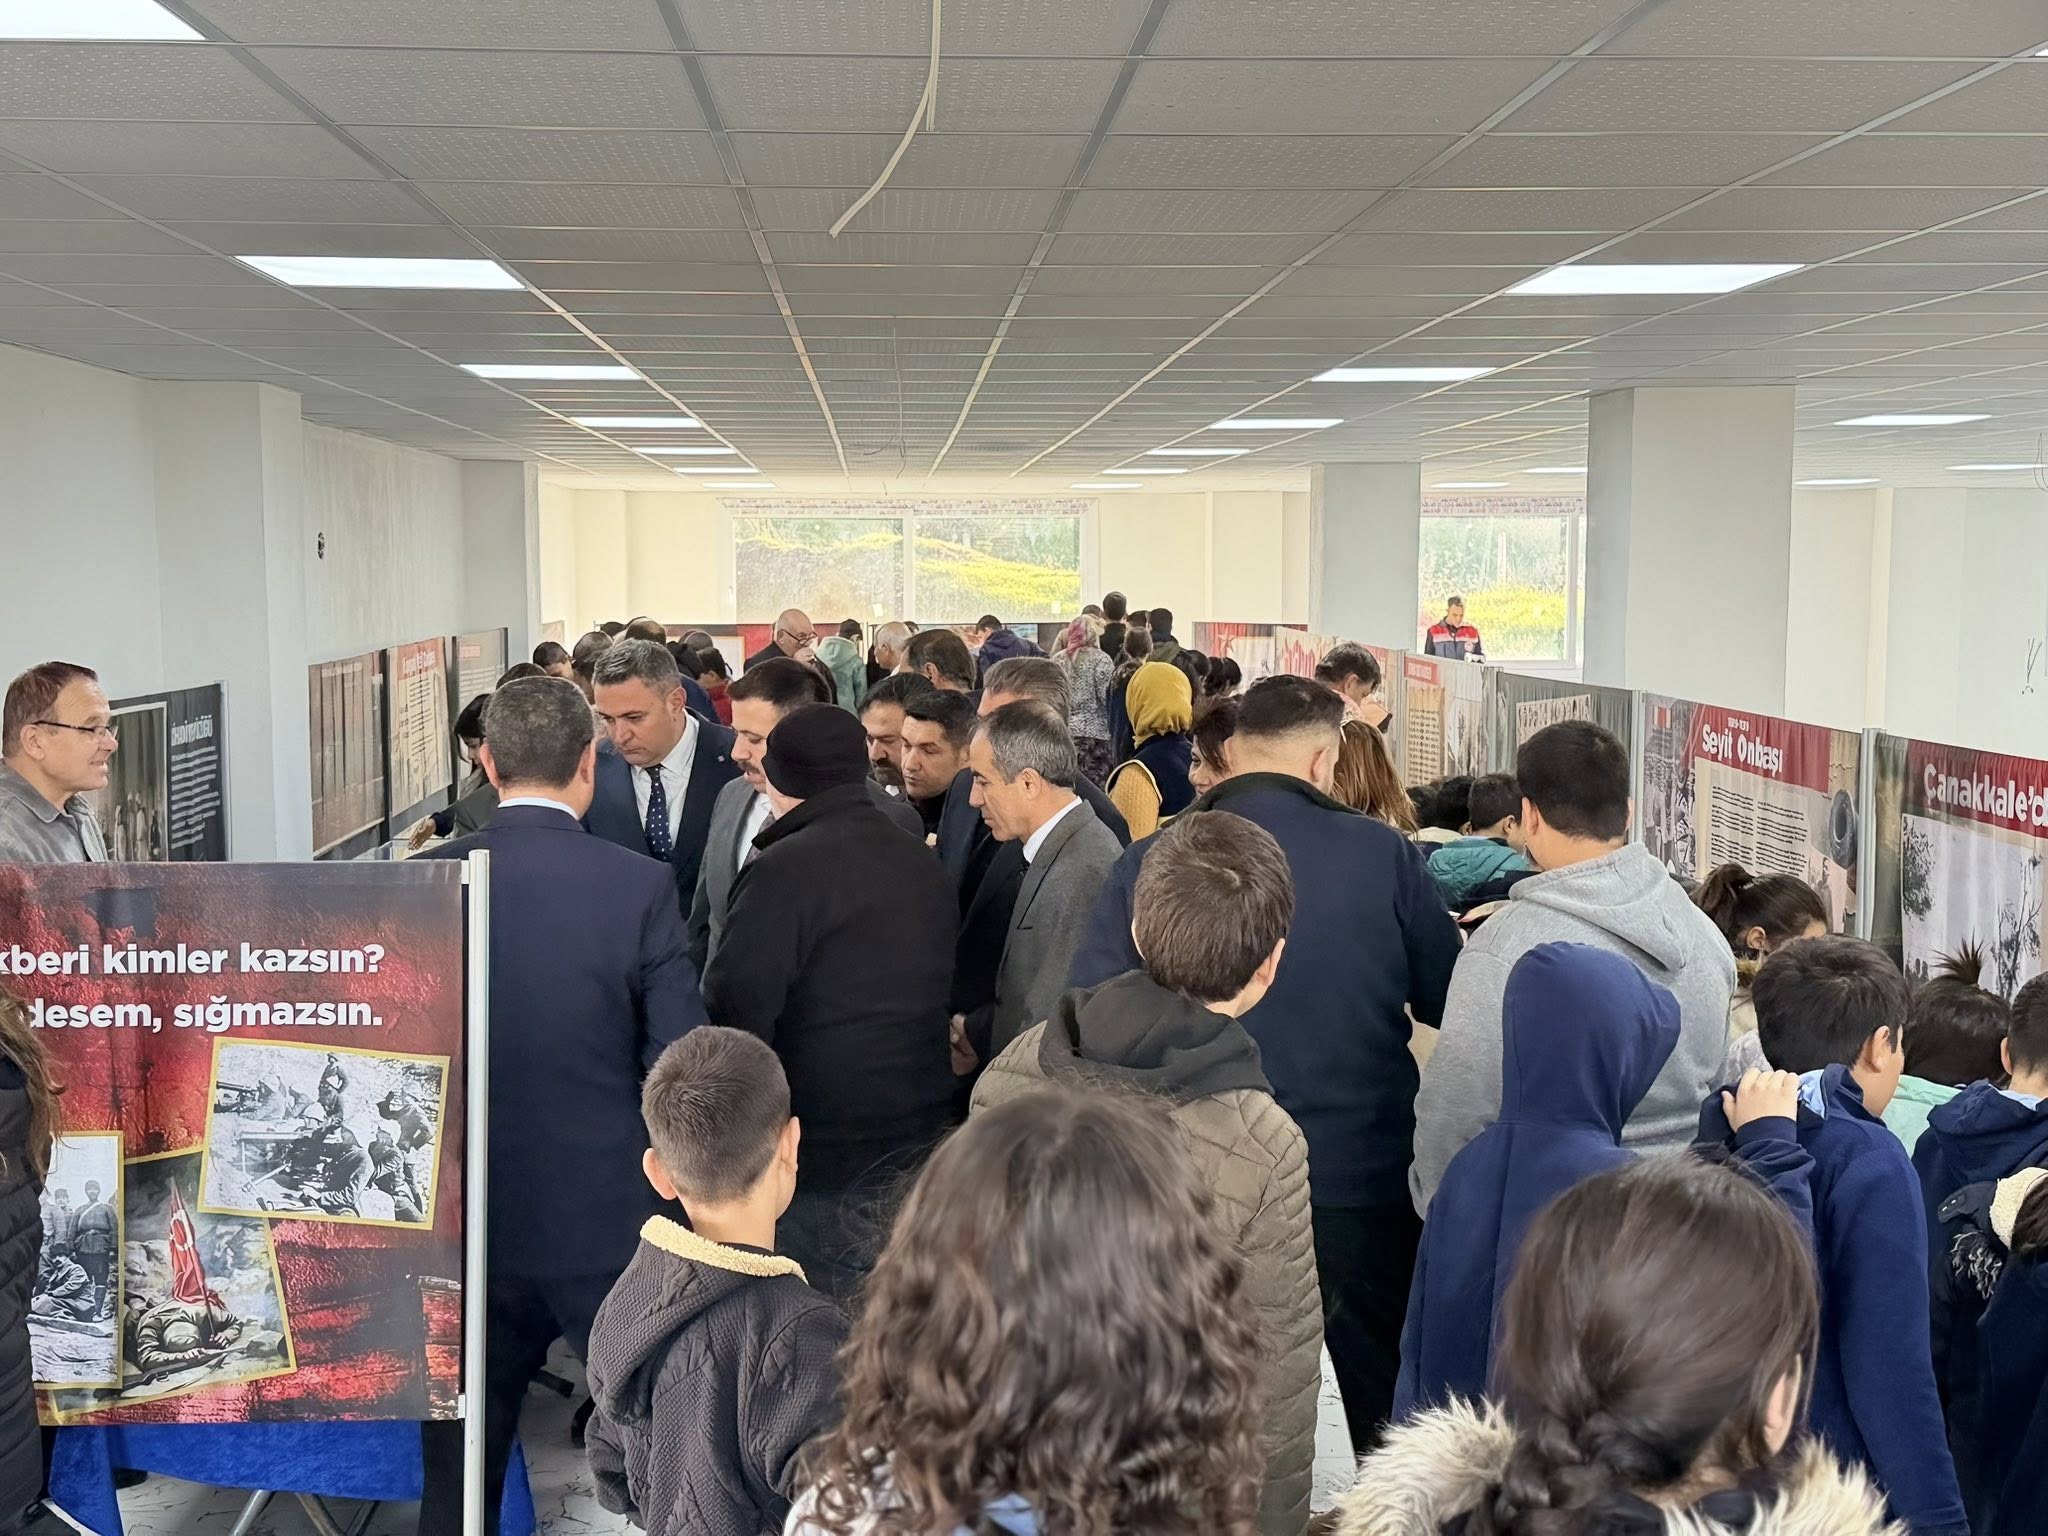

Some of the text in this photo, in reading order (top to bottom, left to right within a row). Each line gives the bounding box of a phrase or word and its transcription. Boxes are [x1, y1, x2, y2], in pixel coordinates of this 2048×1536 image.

[1702, 723, 1783, 777] Seyit Onbaşı
[1923, 763, 2048, 827] Çanakkale'd
[103, 943, 228, 975] kimler
[240, 942, 385, 973] kazsın?
[29, 995, 384, 1034] desem, sığmazsın.
